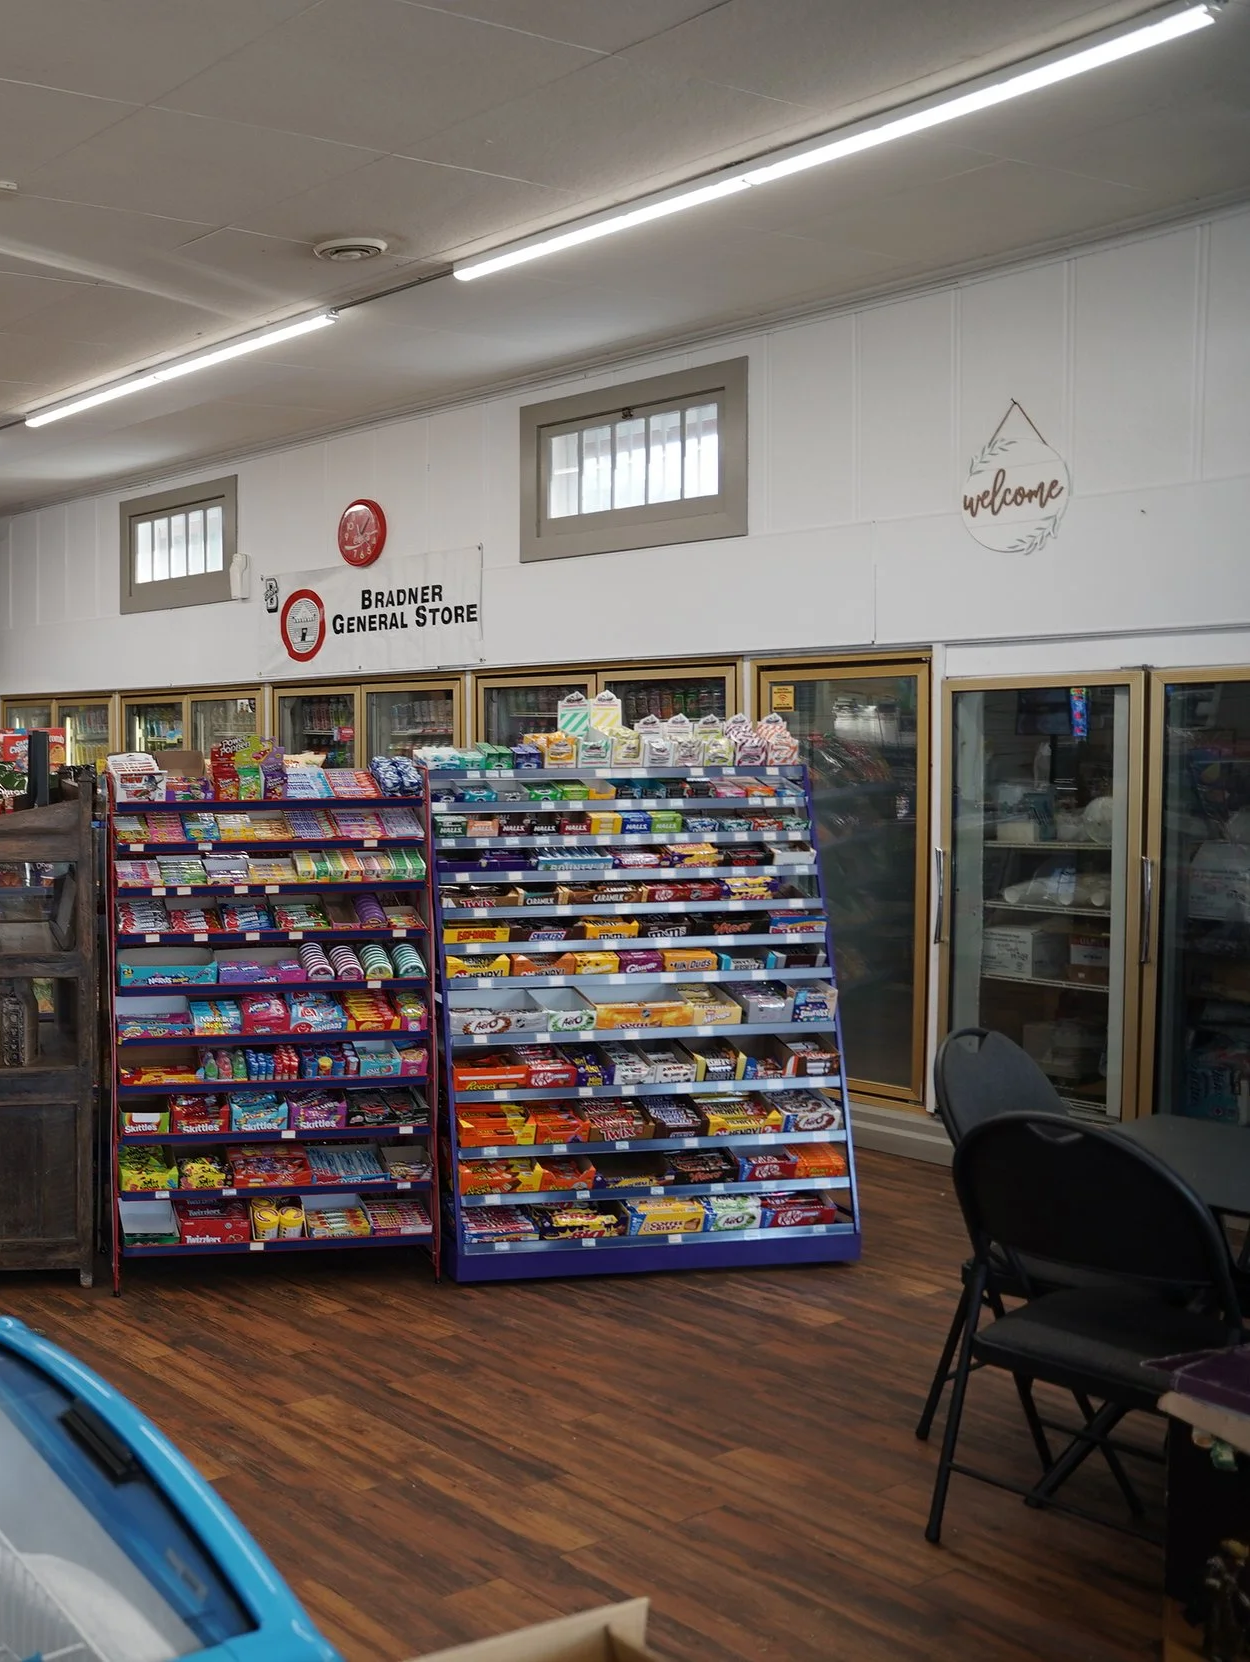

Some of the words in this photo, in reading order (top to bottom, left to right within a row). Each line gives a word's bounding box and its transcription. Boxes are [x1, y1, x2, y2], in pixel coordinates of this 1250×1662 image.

[963, 468, 1064, 517] welcome
[361, 584, 443, 609] BRADNER
[332, 612, 408, 634] GENERAL
[415, 604, 478, 627] STORE
[592, 894, 624, 902] CARAMILK
[531, 932, 566, 940] SNICKERS
[690, 960, 711, 968] Duds
[124, 1124, 158, 1134] Skittles
[183, 1123, 220, 1133] Skittles
[241, 1122, 278, 1131] Skittles
[301, 1120, 336, 1129] Skittles
[185, 1235, 221, 1244] Twizzlers
